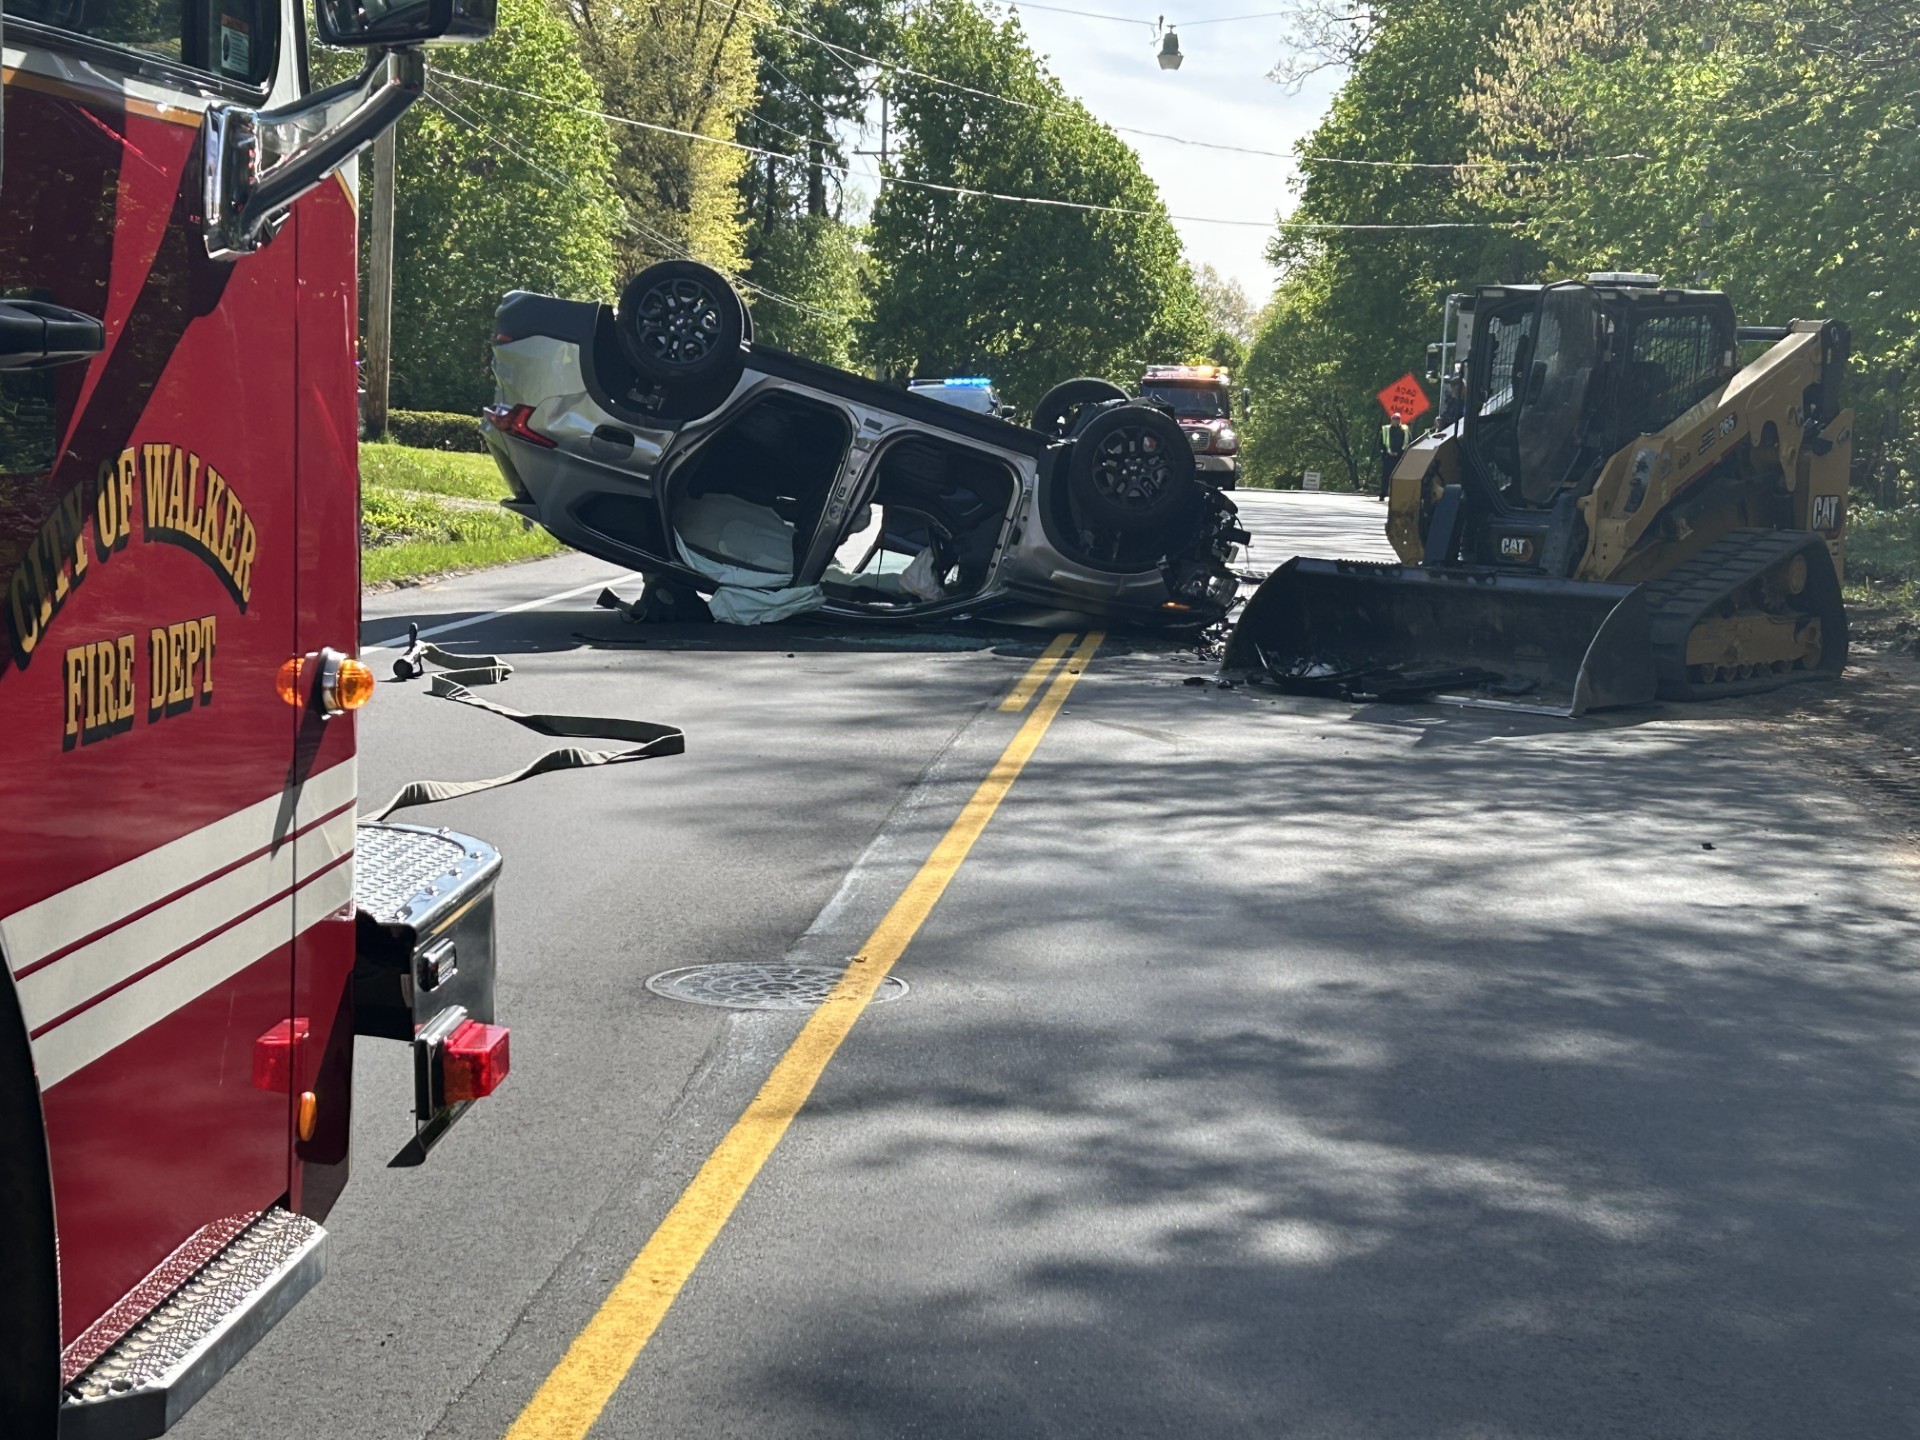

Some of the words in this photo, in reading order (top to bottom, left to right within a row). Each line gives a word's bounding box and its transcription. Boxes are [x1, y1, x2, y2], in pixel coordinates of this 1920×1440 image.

[1393, 395, 1414, 406] WORK
[1812, 496, 1839, 529] CAT
[11, 480, 88, 656] CITY
[97, 447, 136, 549] OF
[142, 443, 256, 604] WALKER
[1501, 538, 1526, 554] CAT
[65, 634, 136, 737] FIRE
[150, 615, 217, 711] DEPT
